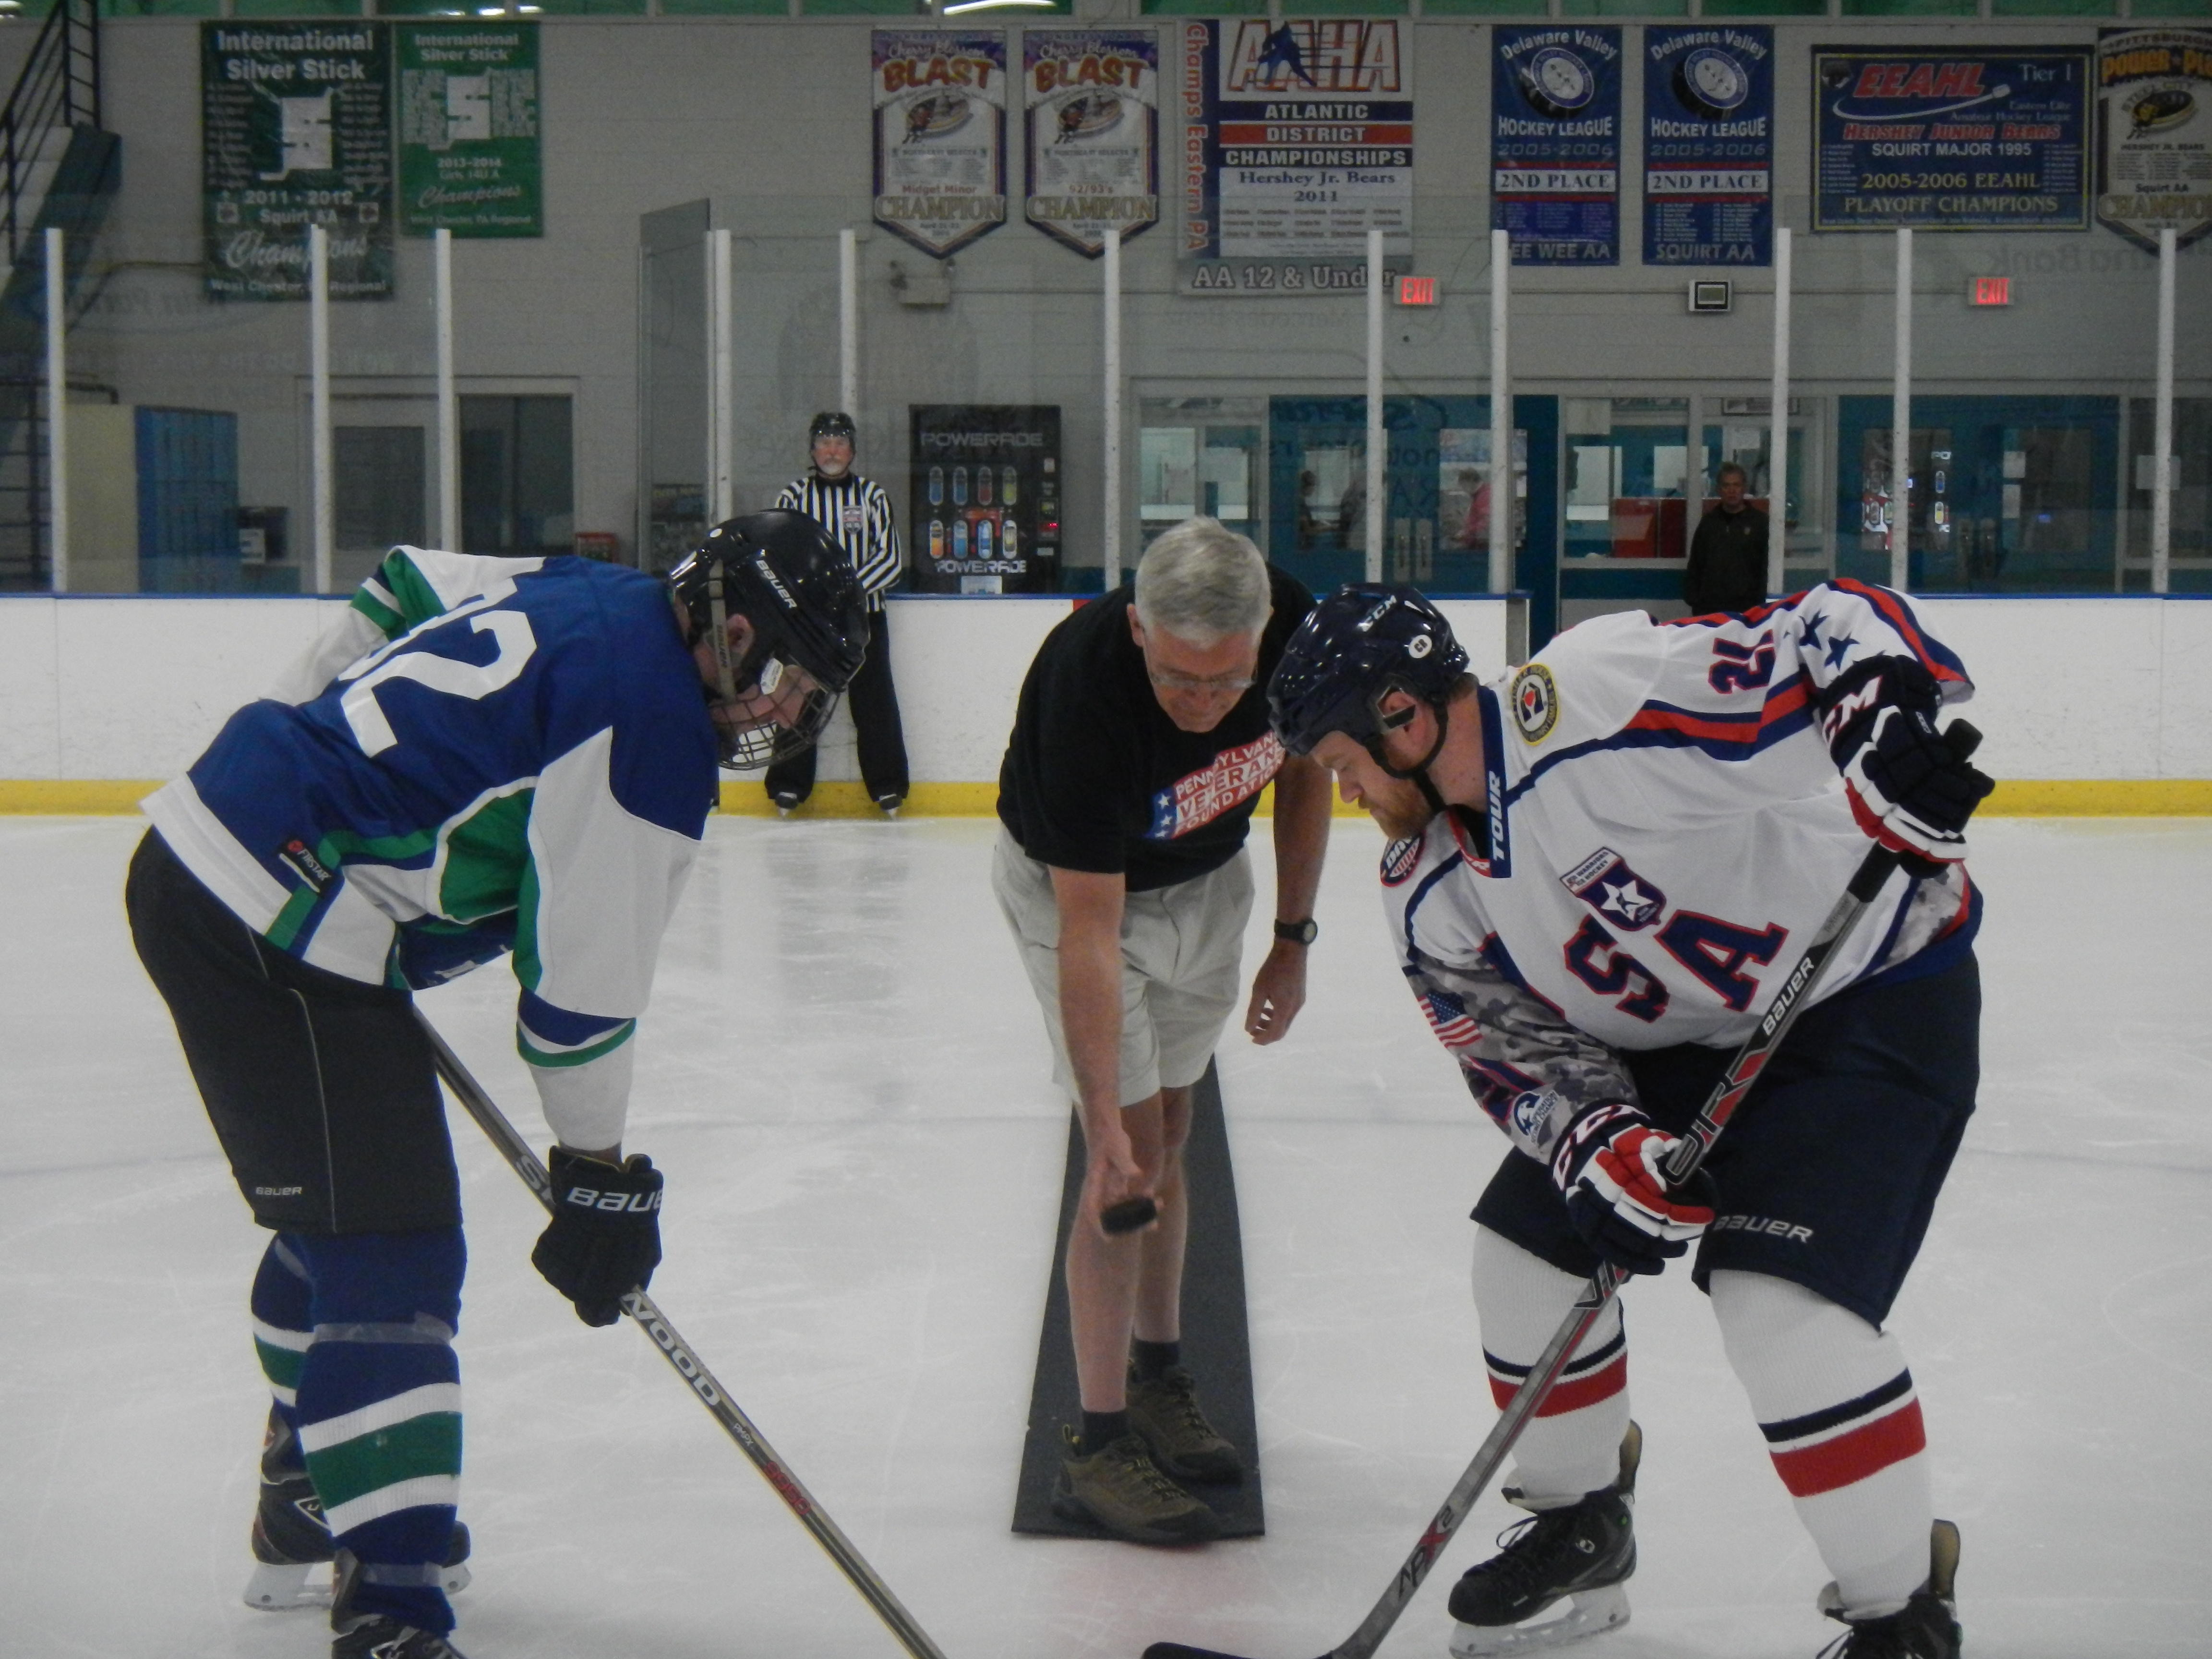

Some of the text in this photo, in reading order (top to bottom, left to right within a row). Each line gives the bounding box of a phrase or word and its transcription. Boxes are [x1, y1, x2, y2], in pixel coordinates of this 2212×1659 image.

[217, 29, 373, 51] International
[415, 33, 519, 47] International
[1500, 30, 1619, 61] Delaware Valley
[1650, 29, 1767, 61] Delaware Valley
[421, 48, 509, 61] Silver Stick
[227, 58, 365, 80] Silver Stick
[882, 54, 998, 93] BLAST
[1034, 54, 1150, 93] BLAST
[1853, 63, 1986, 98] EEAHL
[2019, 64, 2056, 82] Tier
[1264, 104, 1369, 120] ATLANTIC
[1266, 127, 1366, 142] DISTRICT
[1498, 115, 1613, 137] HOCKEY LEAGUE
[1651, 117, 1767, 138] HOCKEY LEAGUE
[1843, 122, 2061, 140] HERSHEY JUNIOR BEARS
[1181, 23, 1209, 252] Champs Eastern PA
[1497, 144, 1615, 156] 2005-2006
[1650, 144, 1767, 156] 2005-2006
[1871, 142, 2032, 156] SQUIRT MAJOR 1995
[437, 157, 502, 168] 2013-2014
[1225, 150, 1407, 166] CHAMPIONSHIPS
[1238, 171, 1395, 186] Hershey Jr. Bears
[1500, 173, 1611, 190] 2ND PLACE
[1653, 173, 1762, 190] 2ND PLACE
[1862, 173, 2041, 189] 2005-2006 EEAHL
[902, 184, 978, 196] Midget Minor
[2135, 183, 2170, 193] Squirt
[245, 190, 283, 205] 2011
[313, 190, 353, 205] 2012
[1293, 191, 1338, 203] 2011
[1844, 196, 2058, 213] PLAYOFF CHAMPIONS
[875, 195, 1004, 221] CHAMPION
[1027, 195, 1157, 221] CHAMPION
[260, 209, 338, 226] Squirt AA
[1510, 242, 1611, 260] EE WEE AA
[1655, 243, 1755, 260] SQUIRT AA
[1192, 264, 1397, 289] AA 12 & Undr
[1400, 278, 1434, 304] EXIT
[1975, 277, 2010, 304] EXIT
[920, 433, 1043, 447] POWERADE
[936, 560, 1027, 574] POWERADE
[756, 560, 798, 609] BAUER
[1490, 770, 1506, 861] TOUR
[297, 848, 332, 881] FIRSTAR
[1762, 957, 1815, 1036] BAUER
[255, 1187, 302, 1196] BAUER
